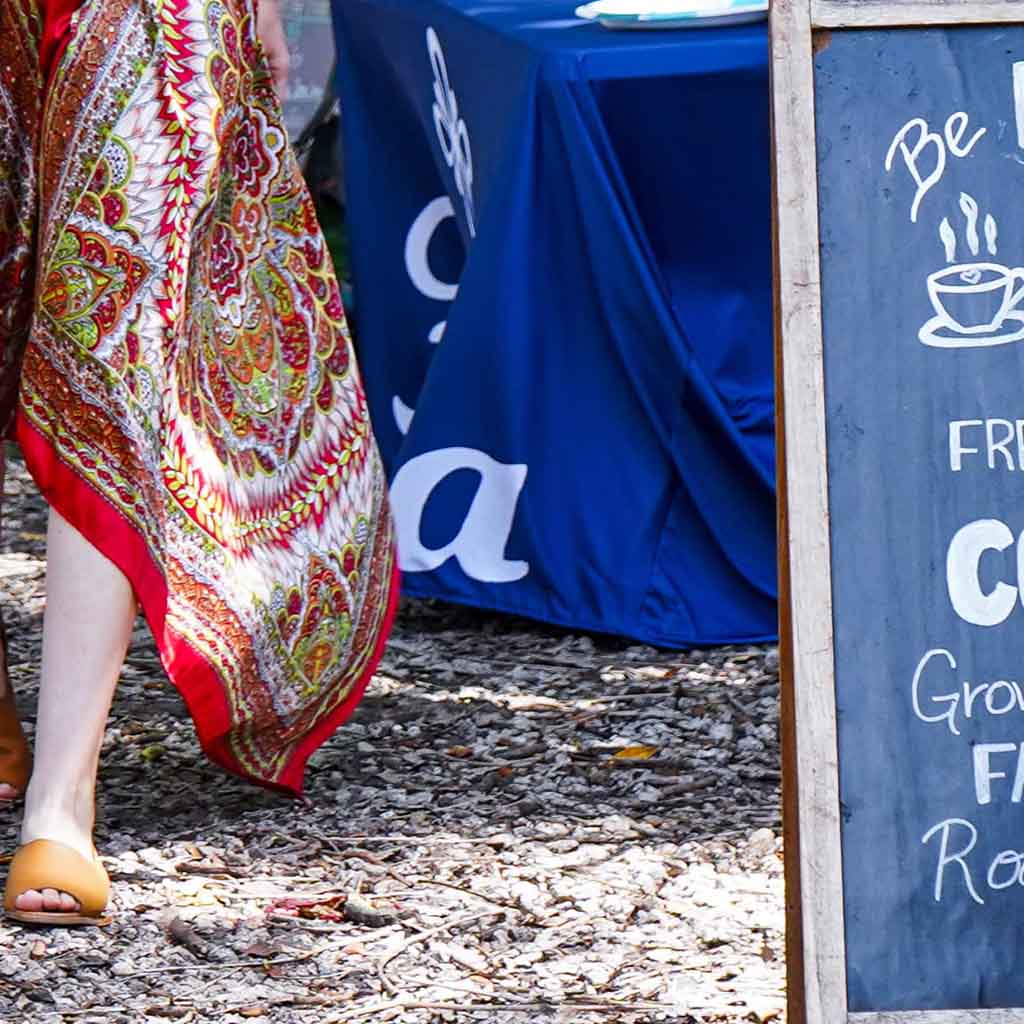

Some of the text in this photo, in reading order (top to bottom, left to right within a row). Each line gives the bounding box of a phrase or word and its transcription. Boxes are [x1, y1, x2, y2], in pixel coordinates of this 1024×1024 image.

[885, 112, 987, 223] Be
[946, 519, 1024, 627] C
[921, 818, 1024, 905] Ro
